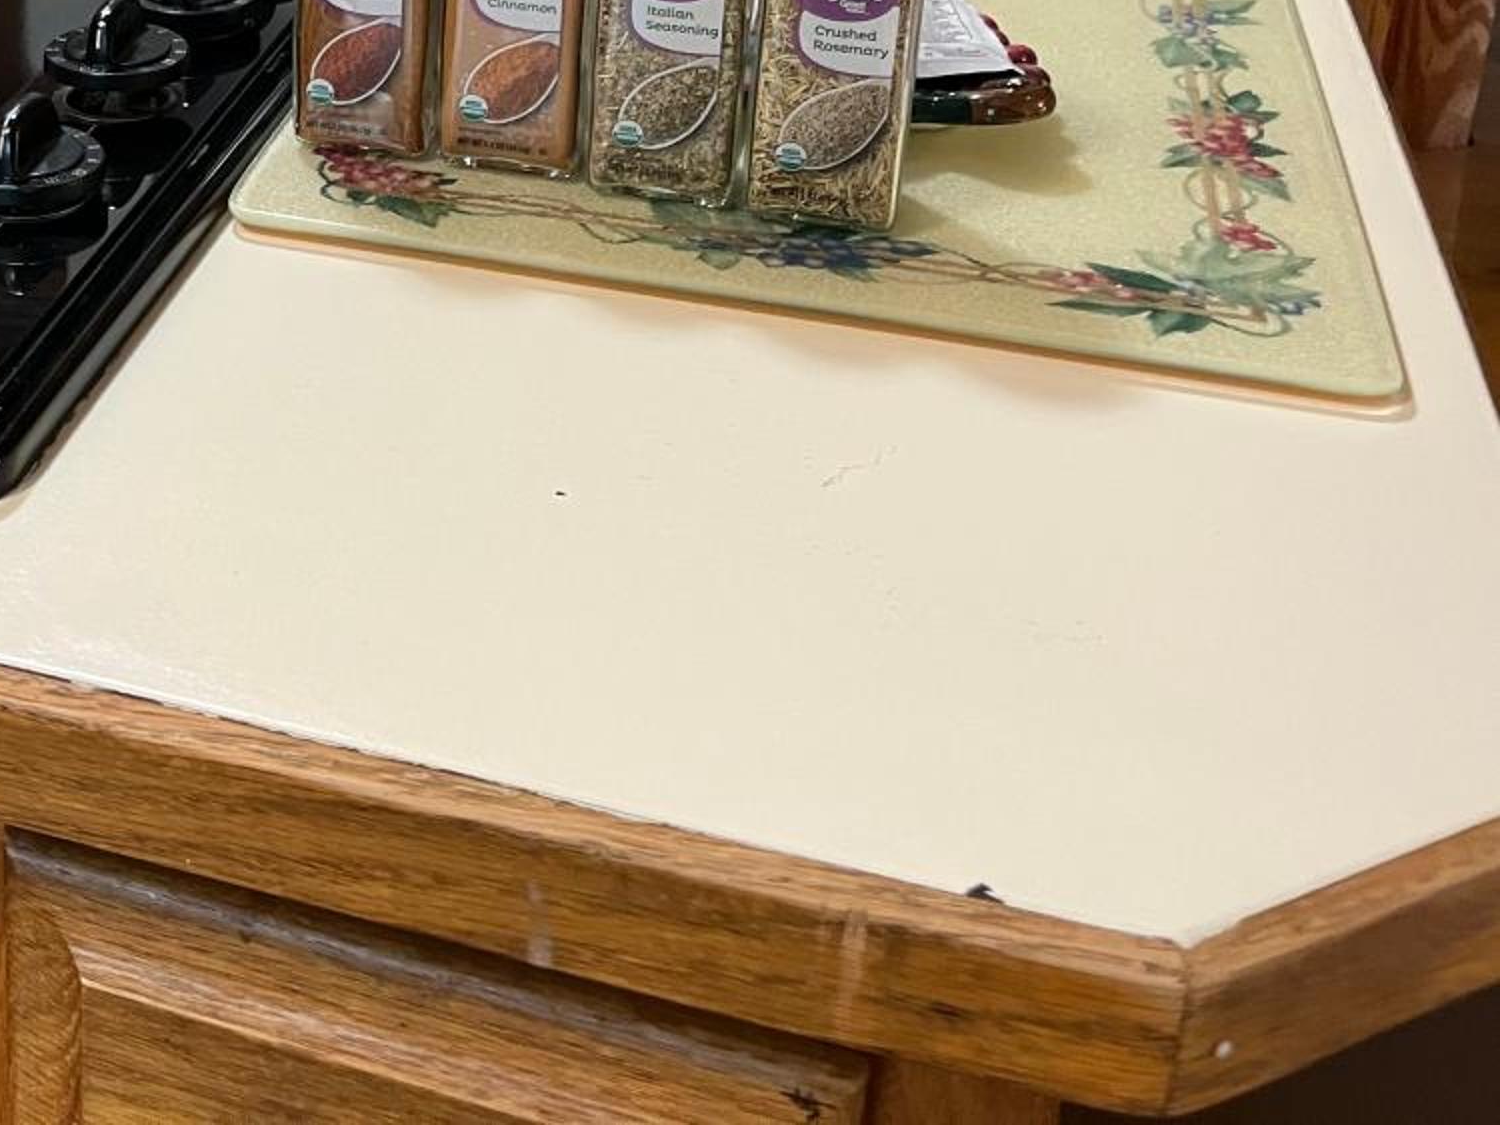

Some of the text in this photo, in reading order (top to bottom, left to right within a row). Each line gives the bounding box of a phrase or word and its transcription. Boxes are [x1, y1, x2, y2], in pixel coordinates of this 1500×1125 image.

[647, 5, 694, 20] Italian
[645, 20, 719, 40] Seasoning
[815, 24, 877, 42] Crushed
[813, 39, 889, 60] Rosemary
